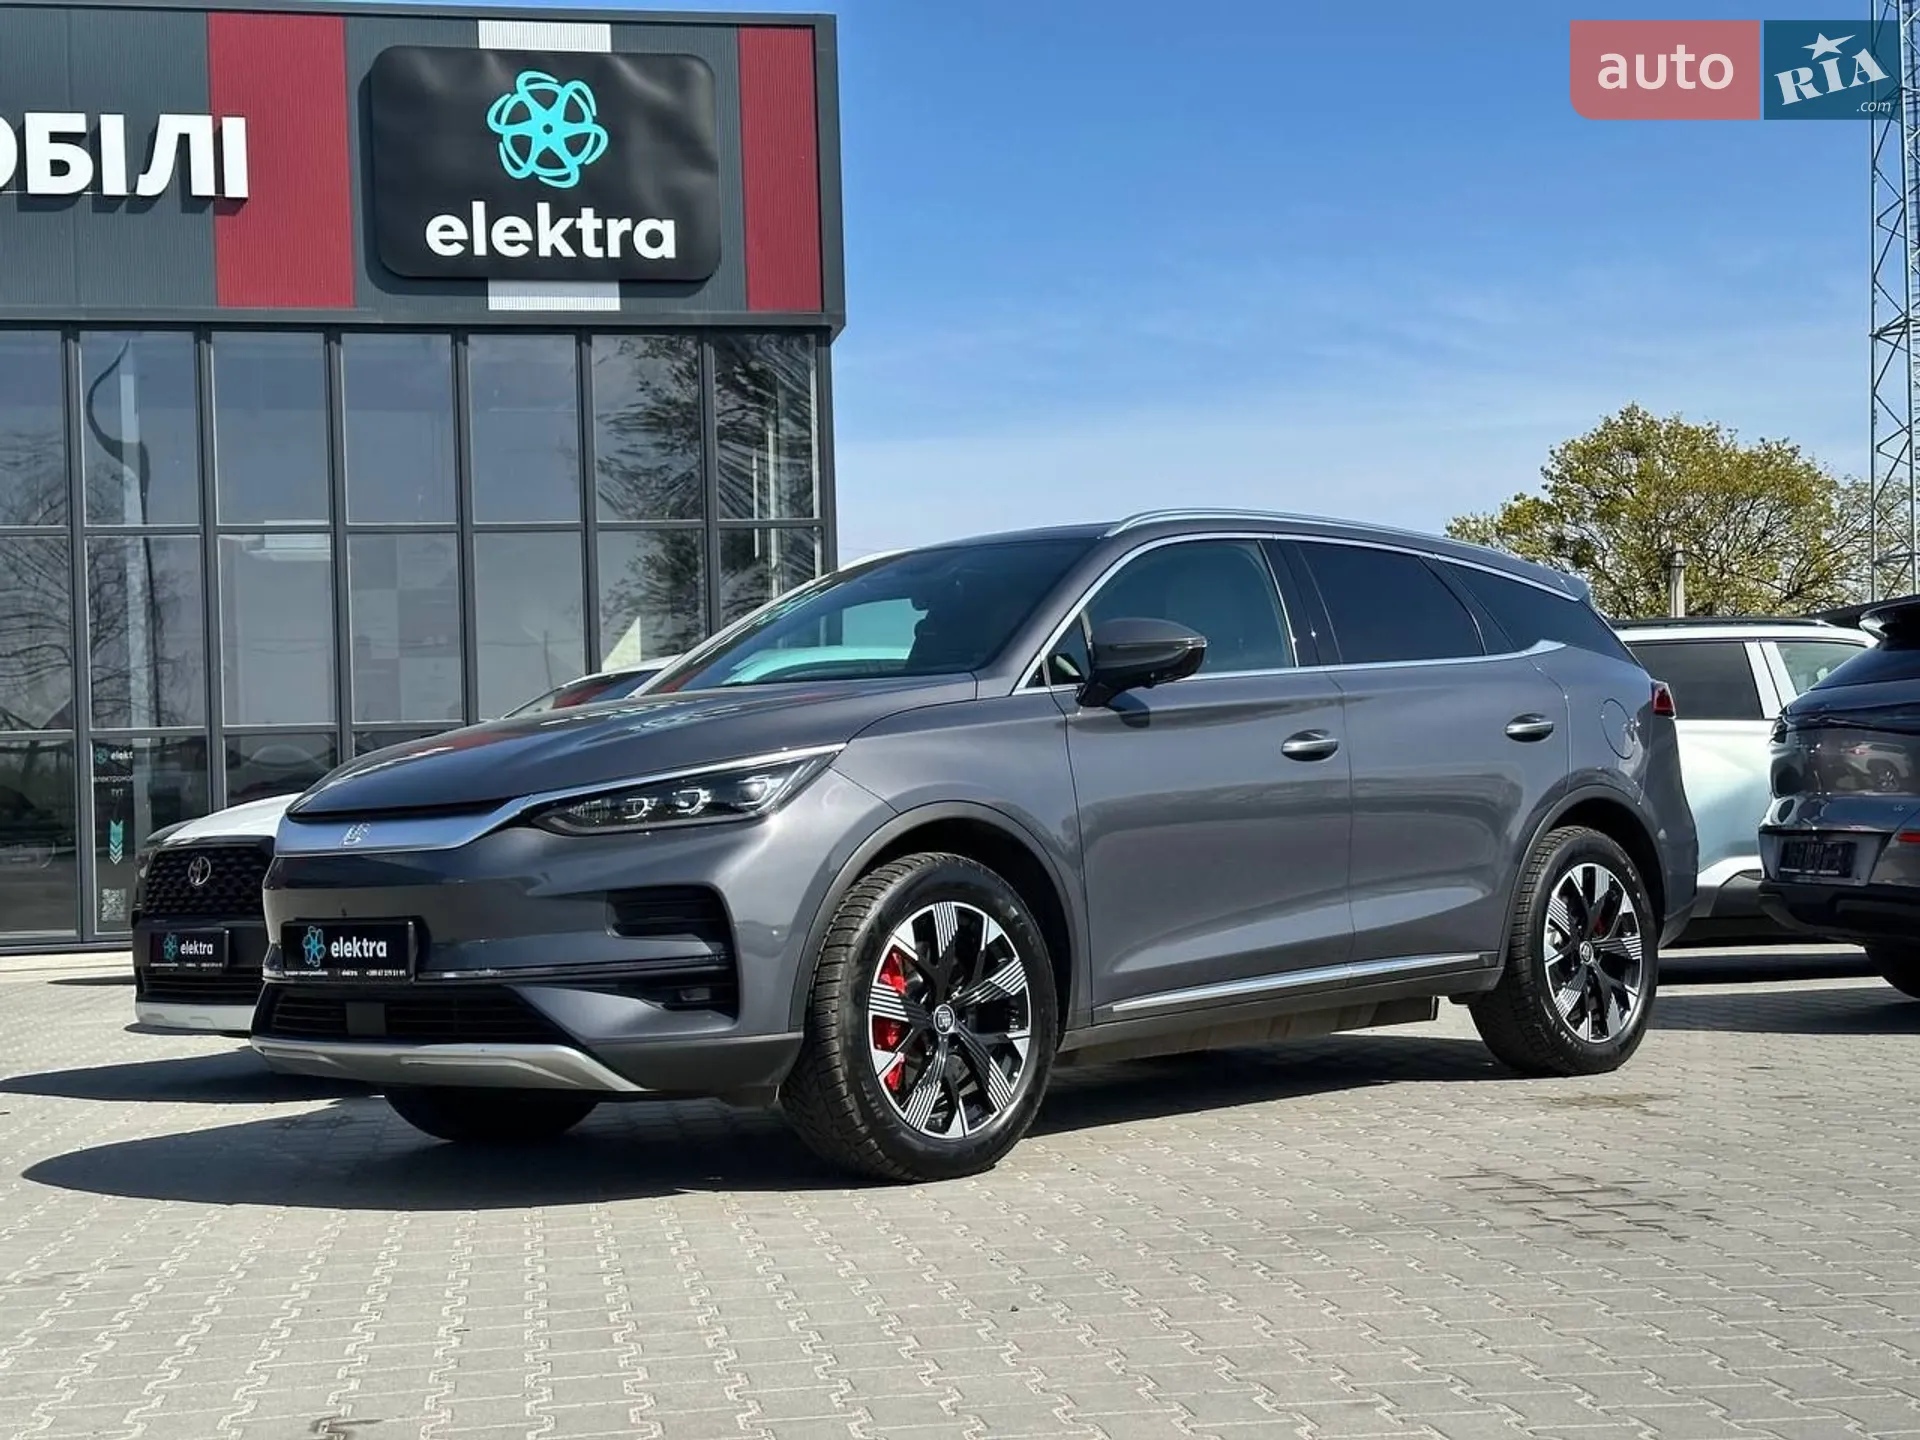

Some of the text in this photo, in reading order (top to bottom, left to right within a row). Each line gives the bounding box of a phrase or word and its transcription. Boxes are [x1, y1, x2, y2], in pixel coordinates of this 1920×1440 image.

[0, 112, 249, 199] БІЛІ
[425, 200, 677, 261] elektra
[180, 940, 214, 955] elektra
[331, 936, 387, 958] elektra
